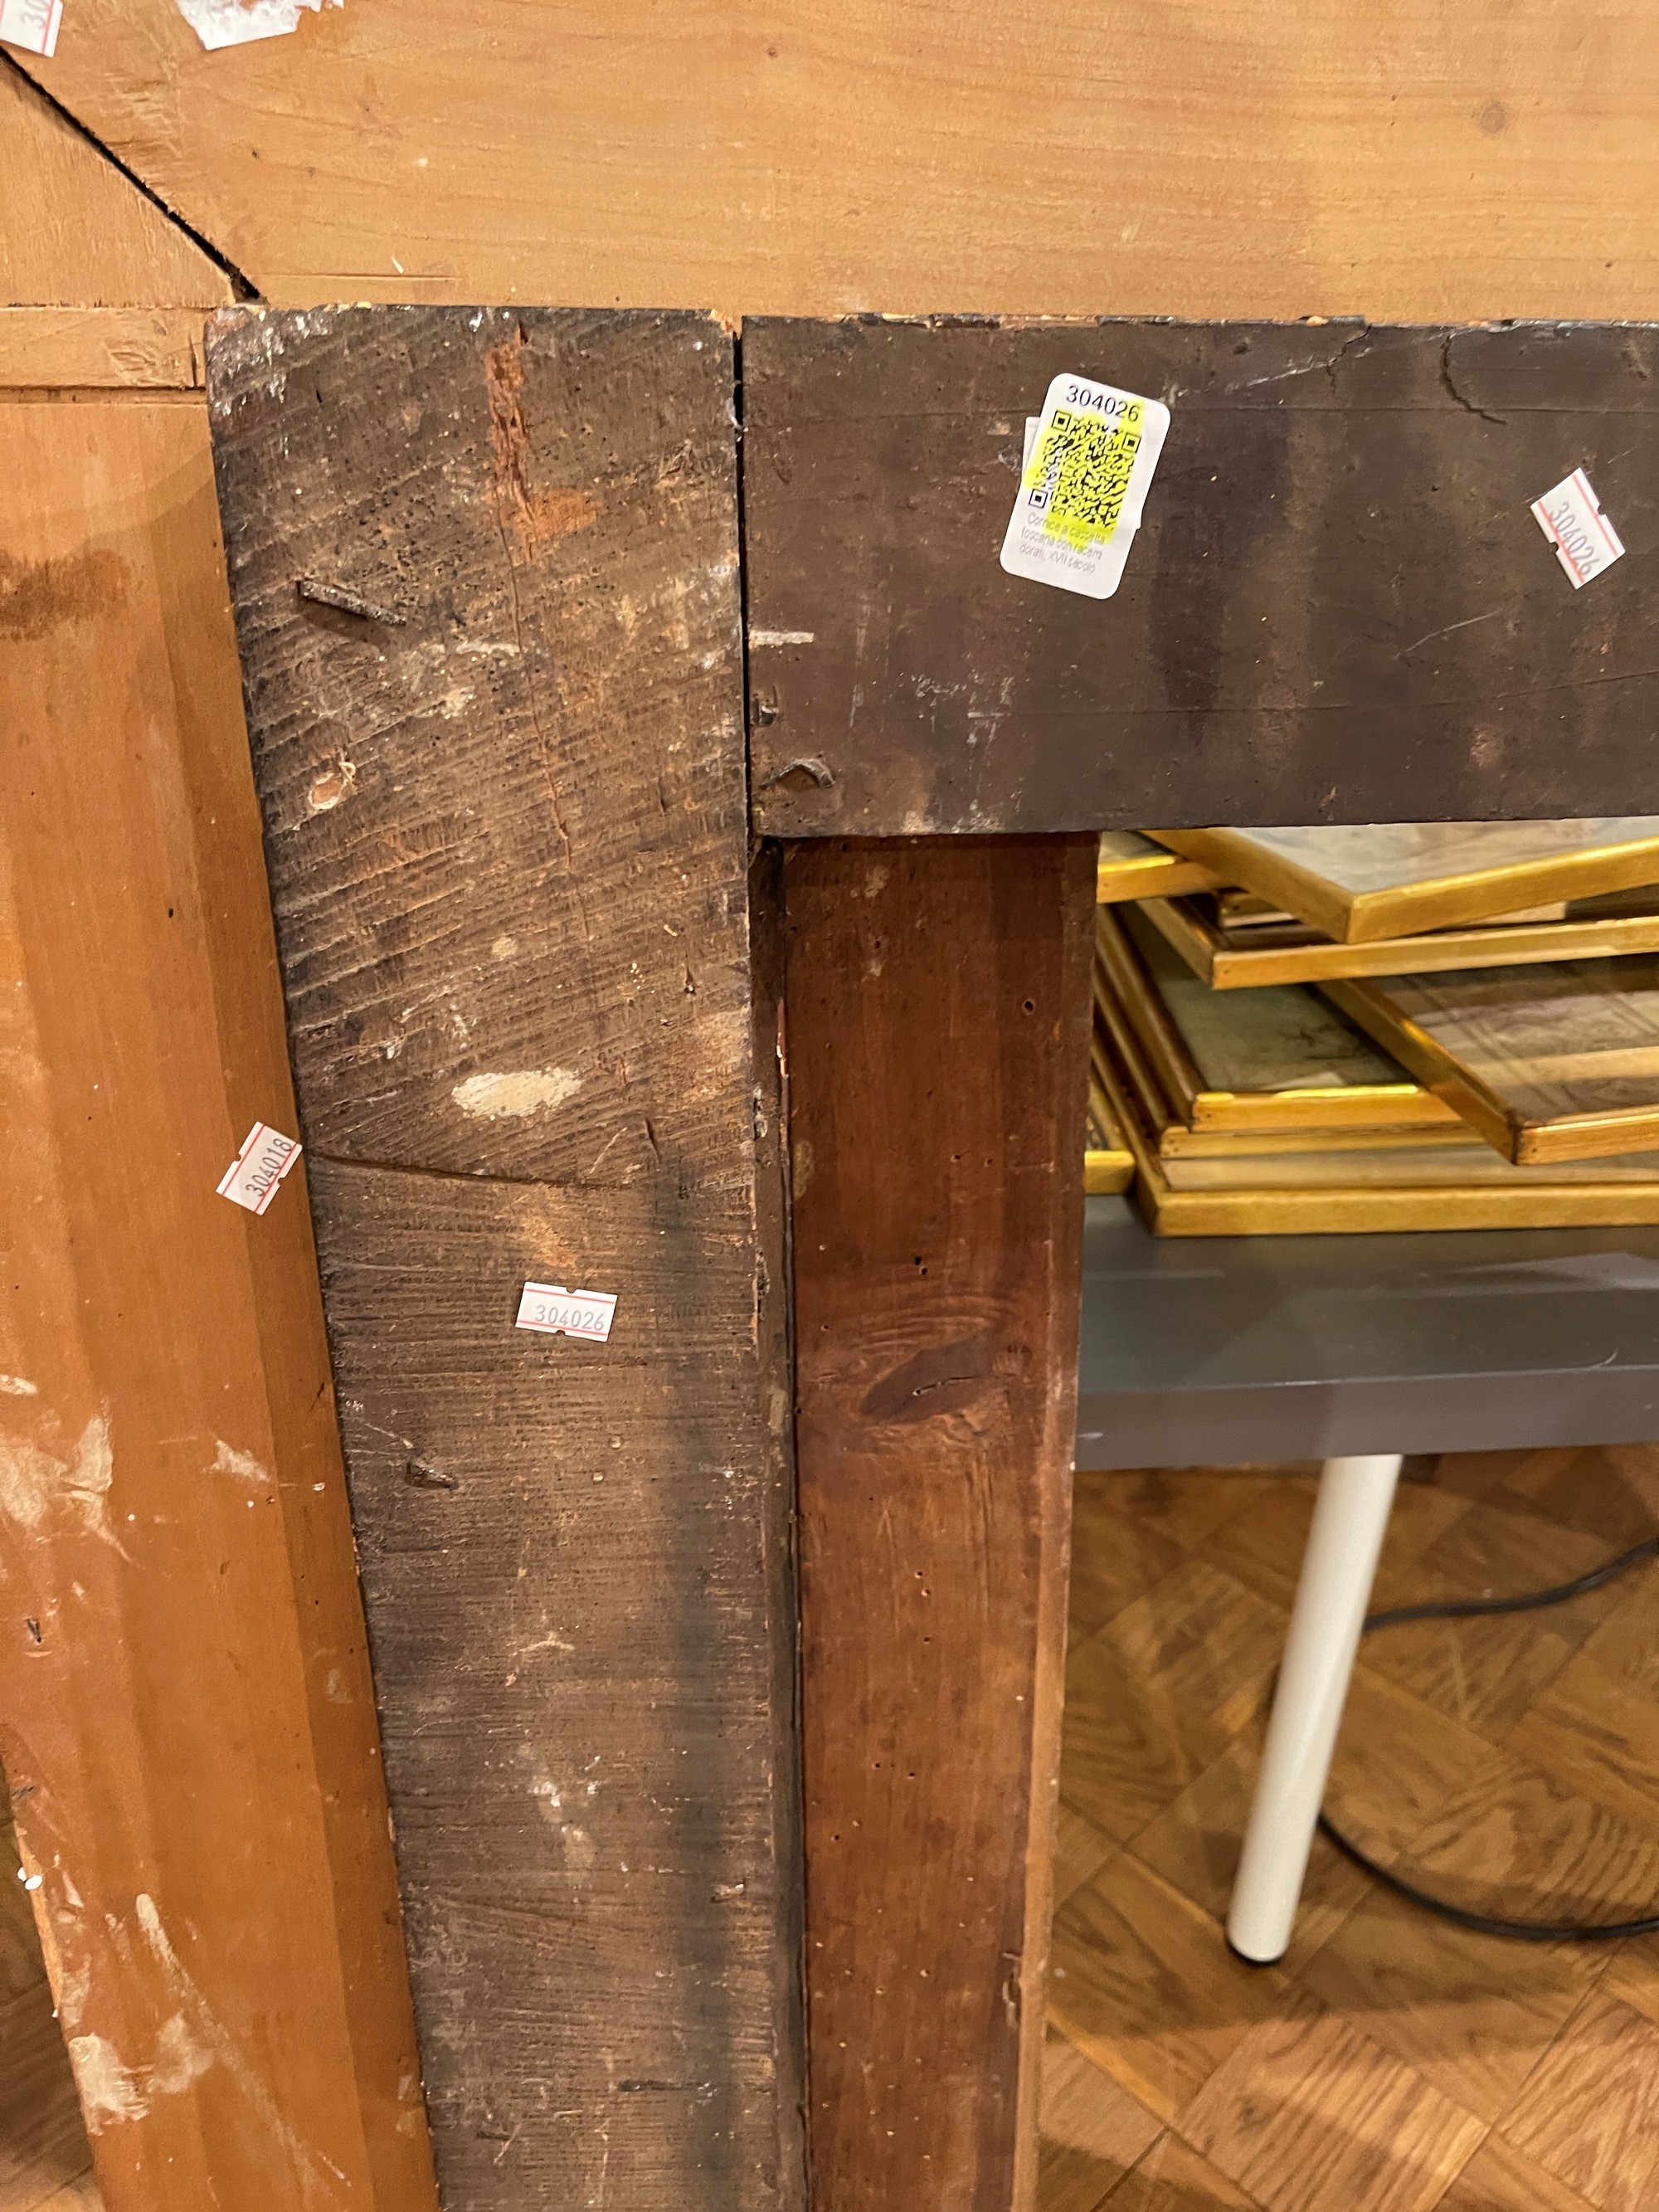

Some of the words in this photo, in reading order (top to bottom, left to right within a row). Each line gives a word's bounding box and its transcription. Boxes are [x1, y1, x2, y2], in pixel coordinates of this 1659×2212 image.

[1066, 385, 1140, 422] 304026
[1062, 525, 1068, 534] a
[1550, 500, 1600, 576] 304026
[246, 1138, 292, 1197] 304018
[535, 1303, 605, 1331] 304026
